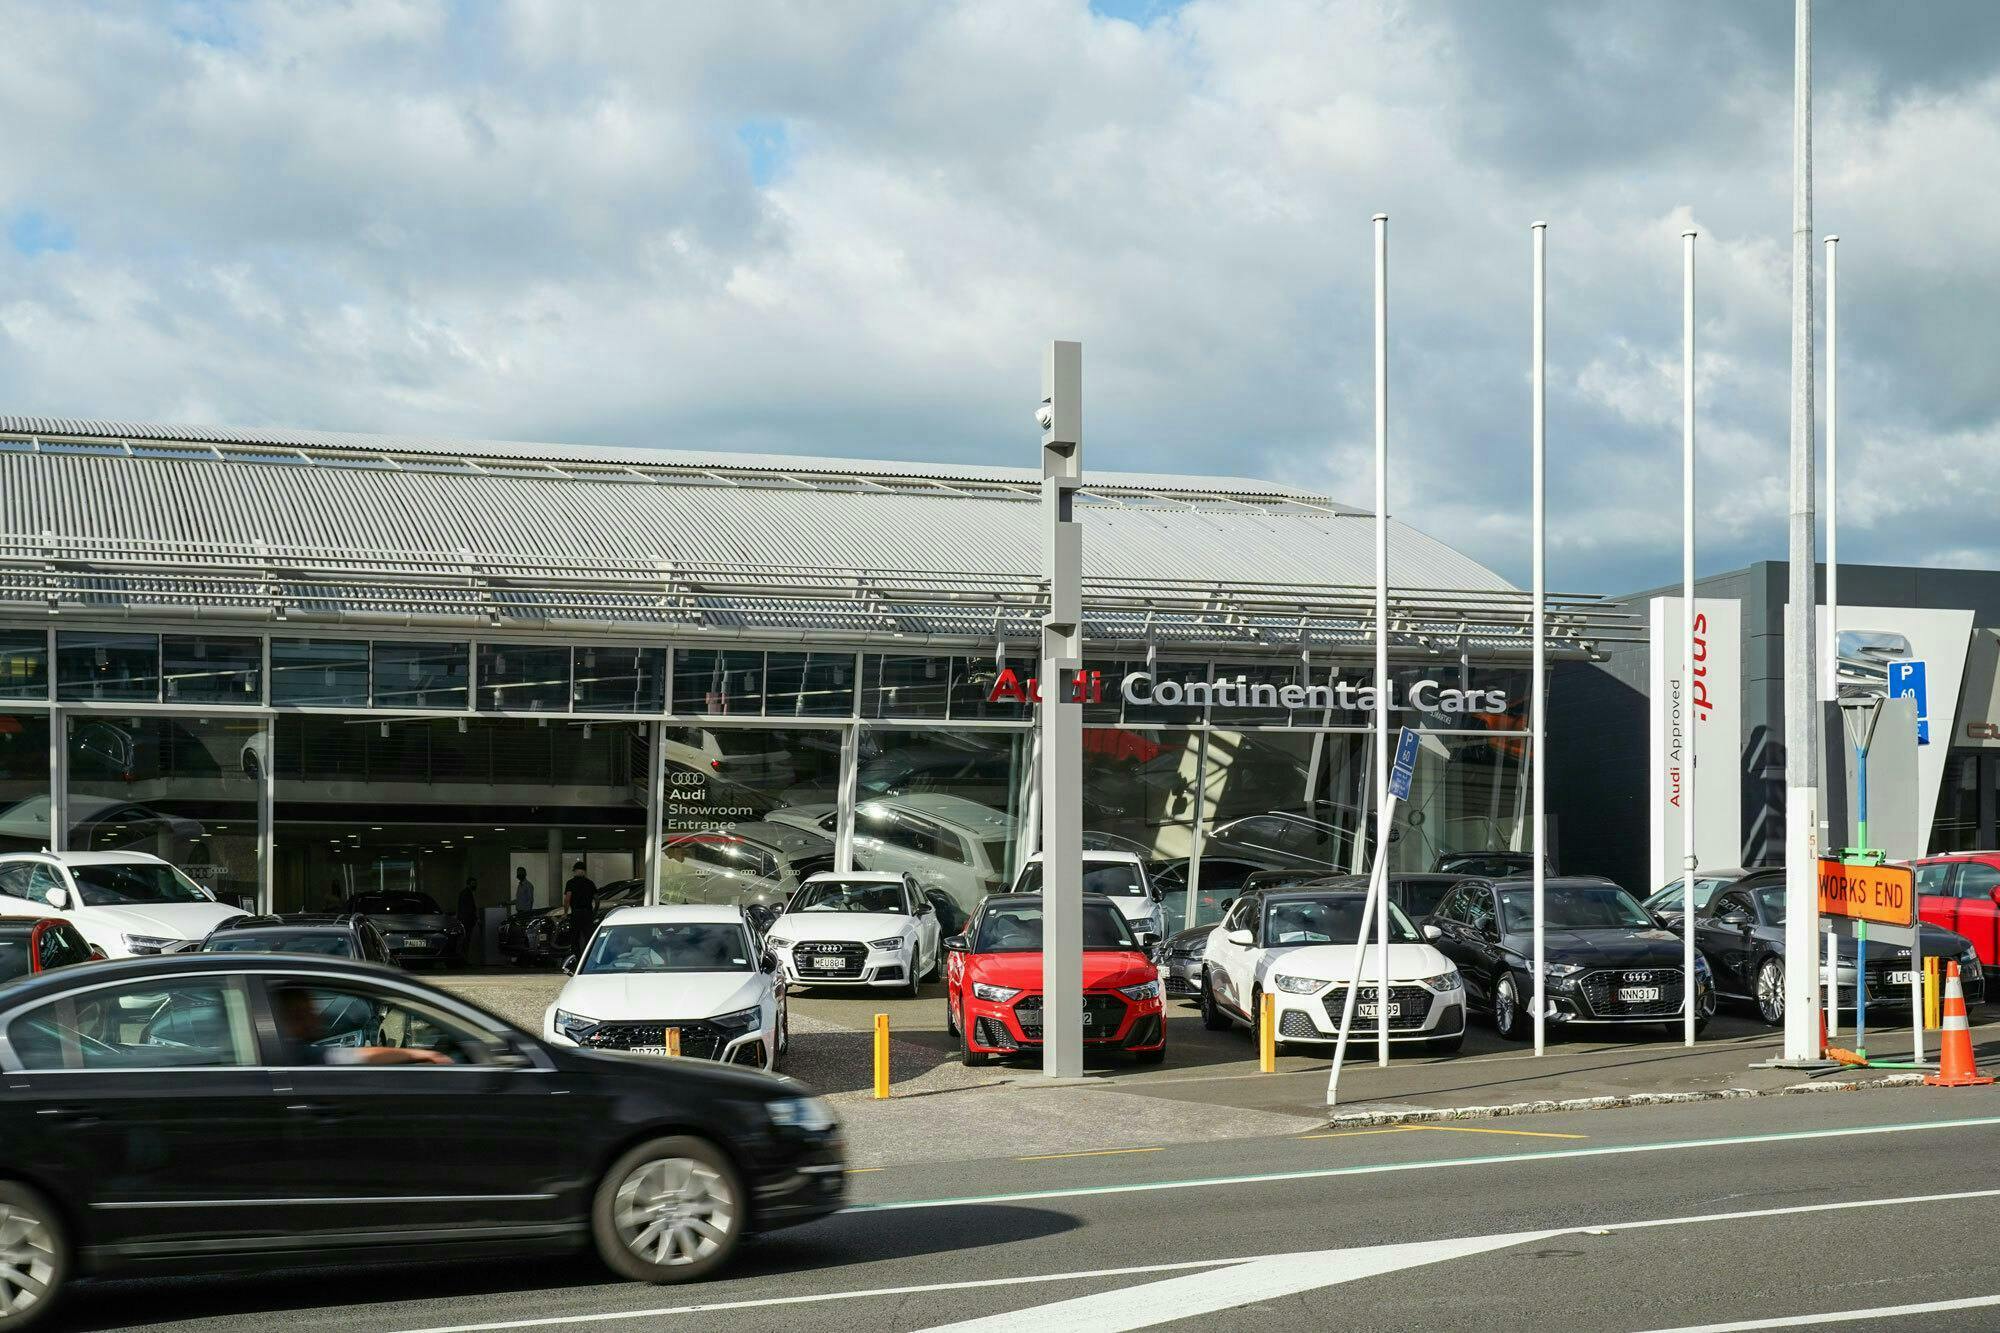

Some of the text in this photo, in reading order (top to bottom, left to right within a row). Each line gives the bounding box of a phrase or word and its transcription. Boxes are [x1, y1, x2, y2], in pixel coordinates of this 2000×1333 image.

[1901, 665, 1914, 681] P
[1120, 672, 1398, 711] Continental
[1409, 680, 1507, 713] Cars
[1405, 732, 1413, 747] P
[1670, 679, 1683, 808] Audi Approved
[669, 789, 706, 800] Audi
[668, 804, 753, 815] Showroom
[668, 819, 736, 830] Entrance
[1818, 874, 1904, 909] WORKS END
[1619, 989, 1658, 999] NNN317
[1359, 1004, 1399, 1015] NZT99
